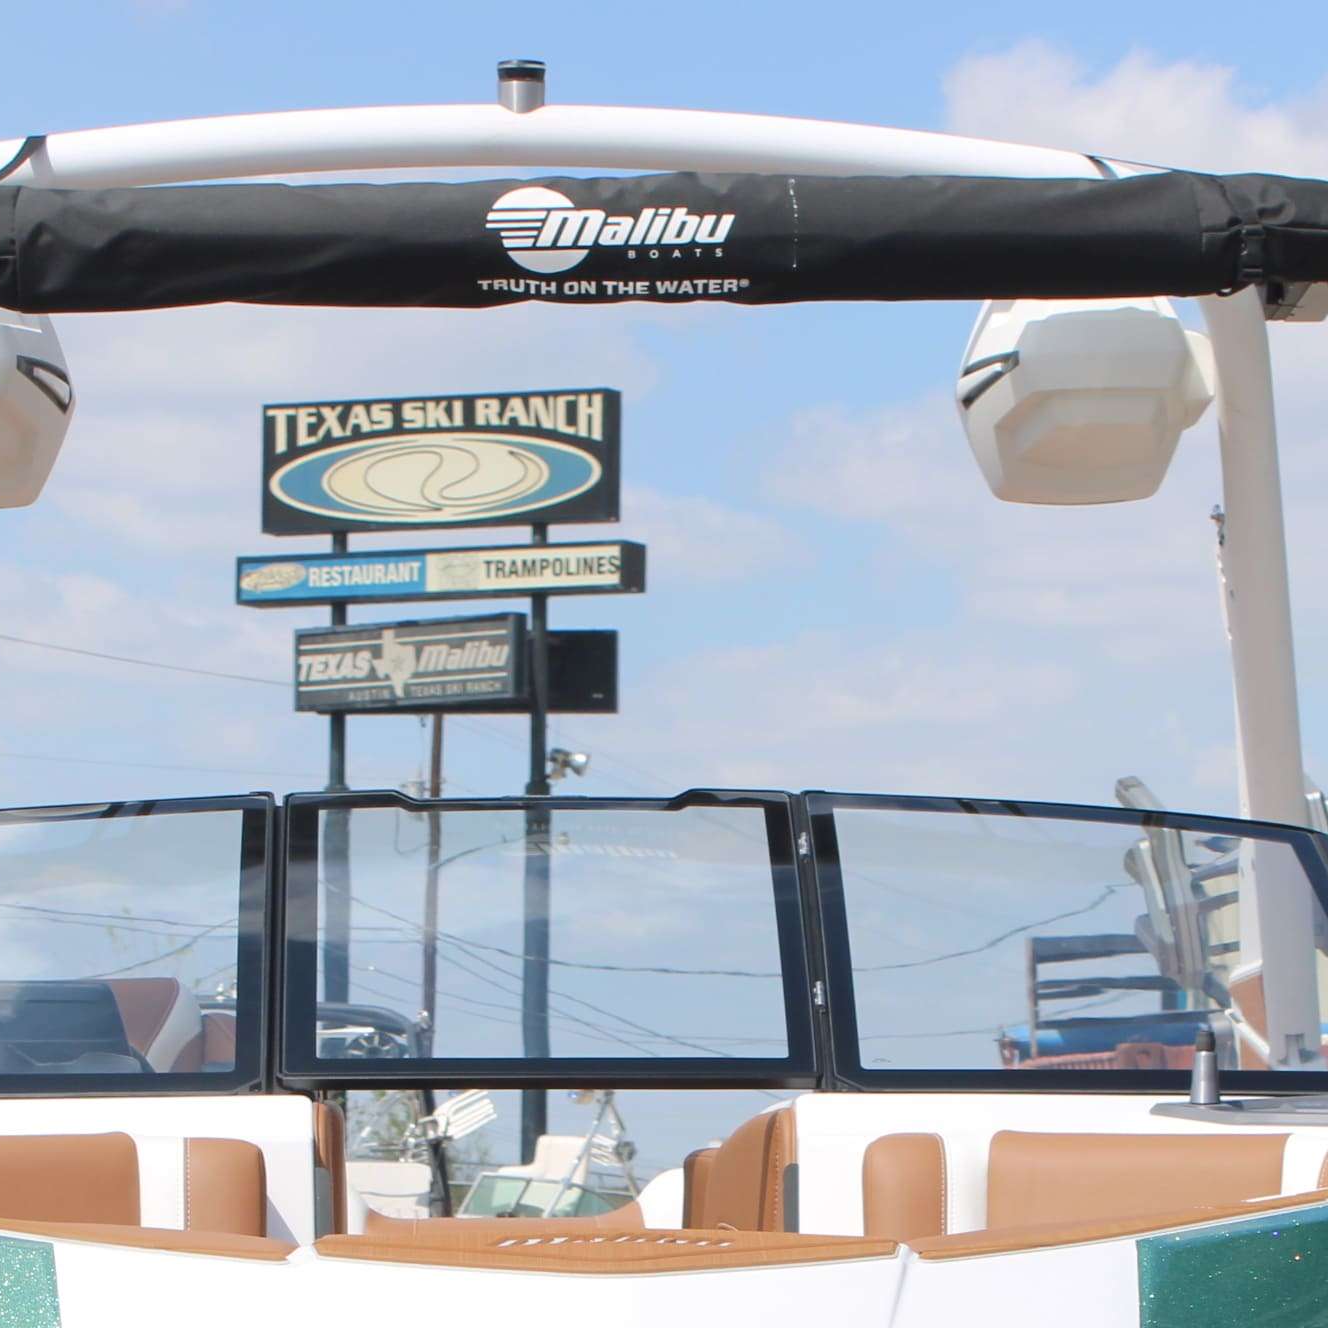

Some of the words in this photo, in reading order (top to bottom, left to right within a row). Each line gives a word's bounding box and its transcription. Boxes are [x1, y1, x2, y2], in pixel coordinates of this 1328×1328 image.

[534, 207, 735, 247] Malibu
[627, 248, 723, 259] BOATS
[477, 279, 557, 295] TRUTH
[563, 280, 598, 295] ON
[603, 280, 649, 295] THE
[265, 402, 394, 455] TEXAS
[402, 399, 465, 429] SKI
[474, 392, 604, 441] RANCH
[307, 560, 422, 587] RESTAURANT
[483, 554, 622, 580] TRAMPOLINES
[298, 650, 372, 682] TEXAS
[416, 640, 510, 673] Malibu
